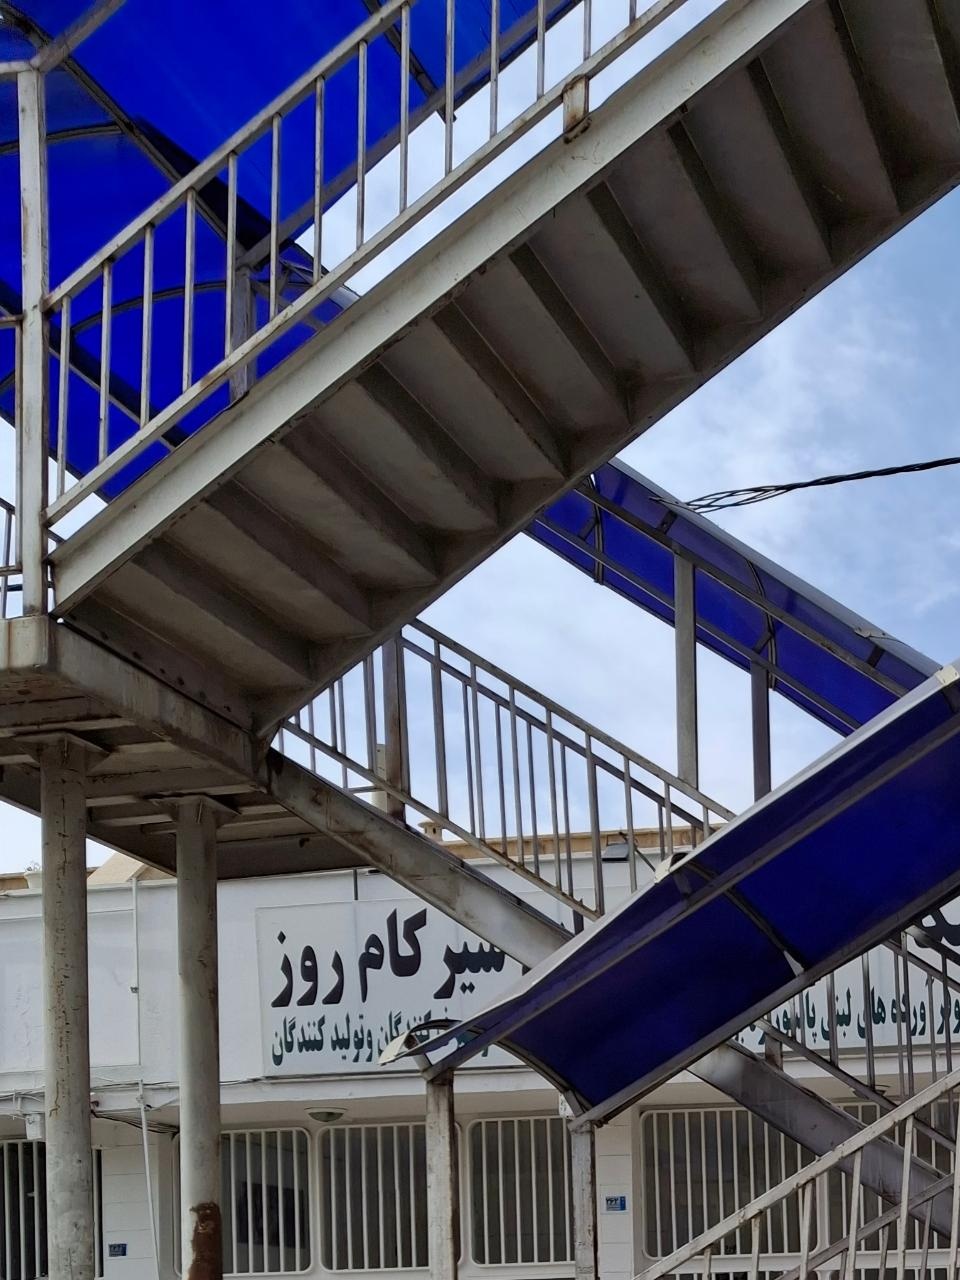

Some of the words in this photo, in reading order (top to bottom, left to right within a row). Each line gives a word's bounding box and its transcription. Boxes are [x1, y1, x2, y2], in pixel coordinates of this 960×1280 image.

[271, 930, 344, 1008] روز
[358, 908, 427, 1002] کام
[272, 1014, 326, 1066] کنندگان
